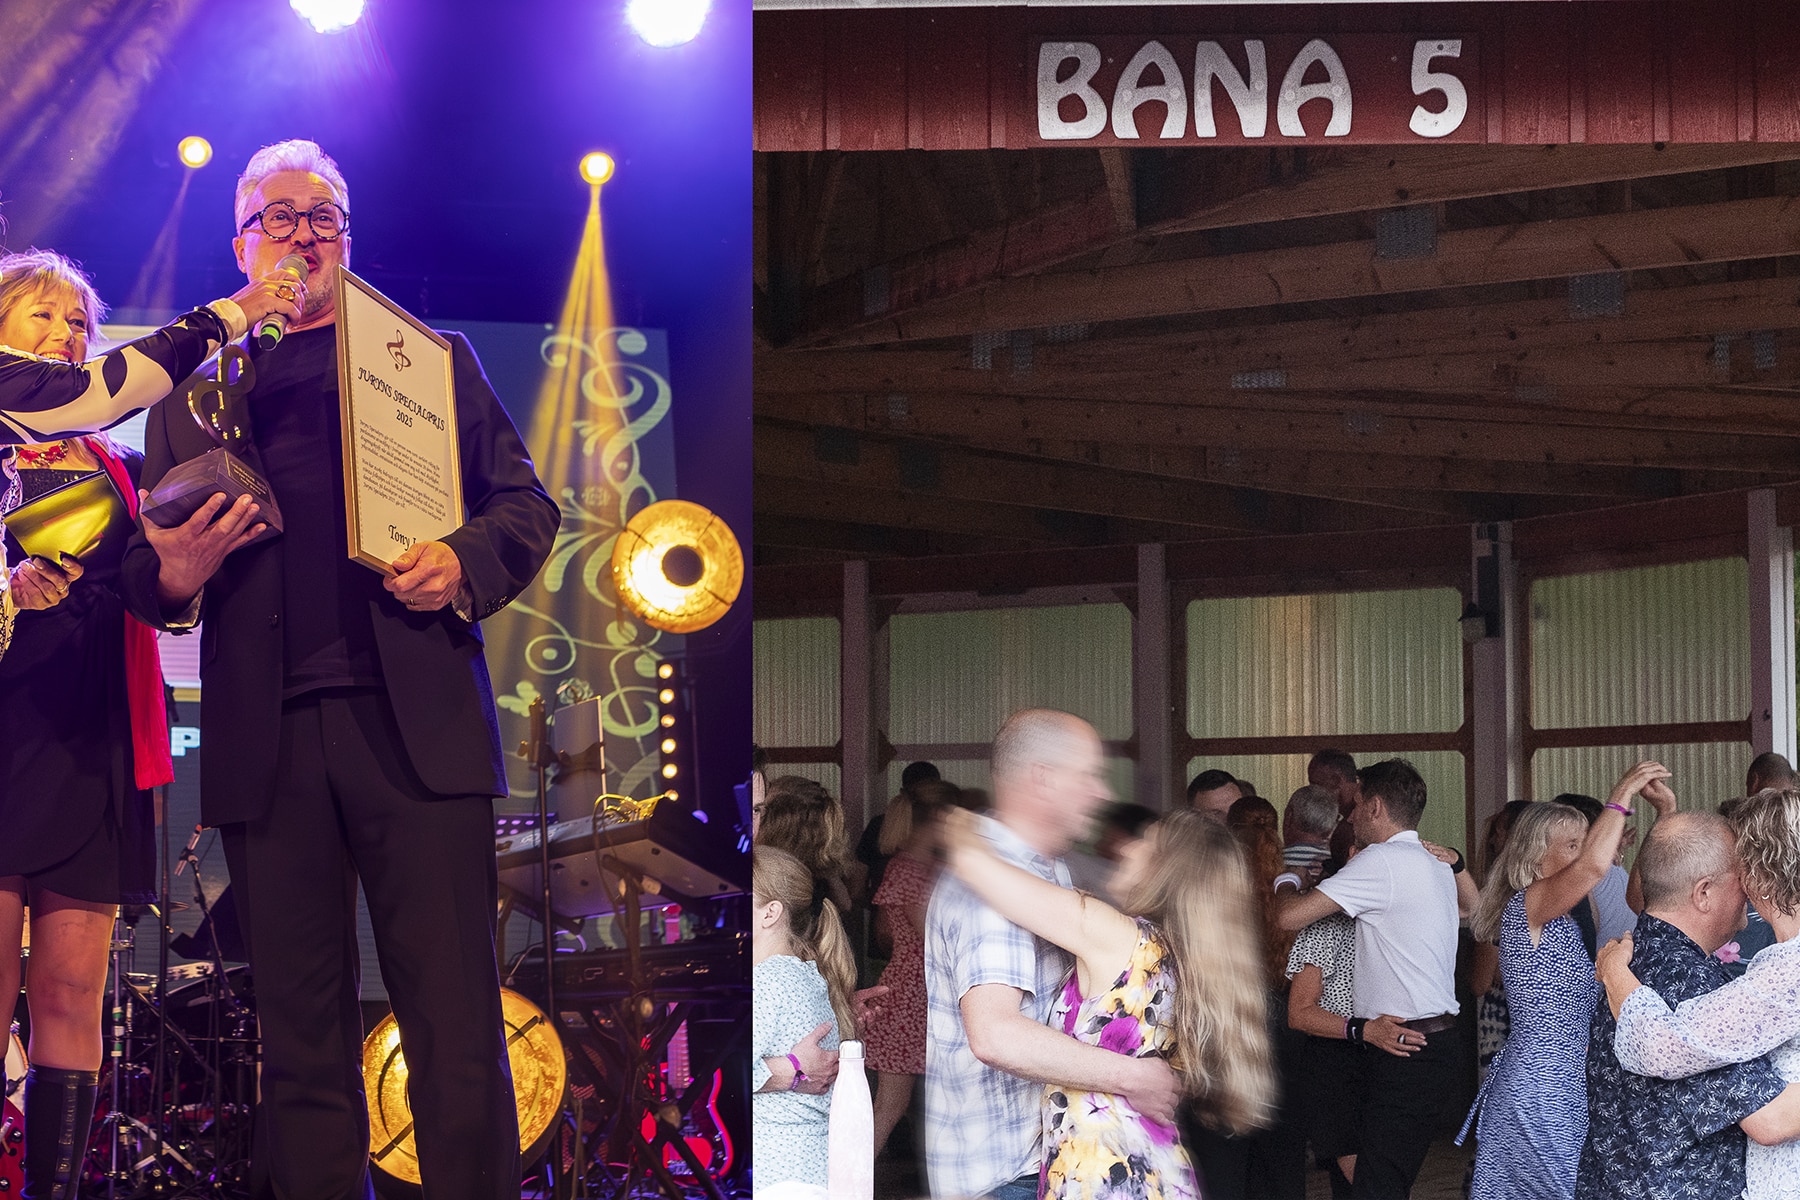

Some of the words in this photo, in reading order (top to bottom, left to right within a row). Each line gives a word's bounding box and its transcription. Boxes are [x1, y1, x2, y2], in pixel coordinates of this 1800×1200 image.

[1037, 38, 1353, 140] BANA
[1409, 39, 1468, 138] 5
[357, 366, 393, 398] JURYNS
[392, 389, 445, 431] SPECIALPRIS
[396, 409, 413, 428] 2025
[388, 524, 410, 552] Tony
